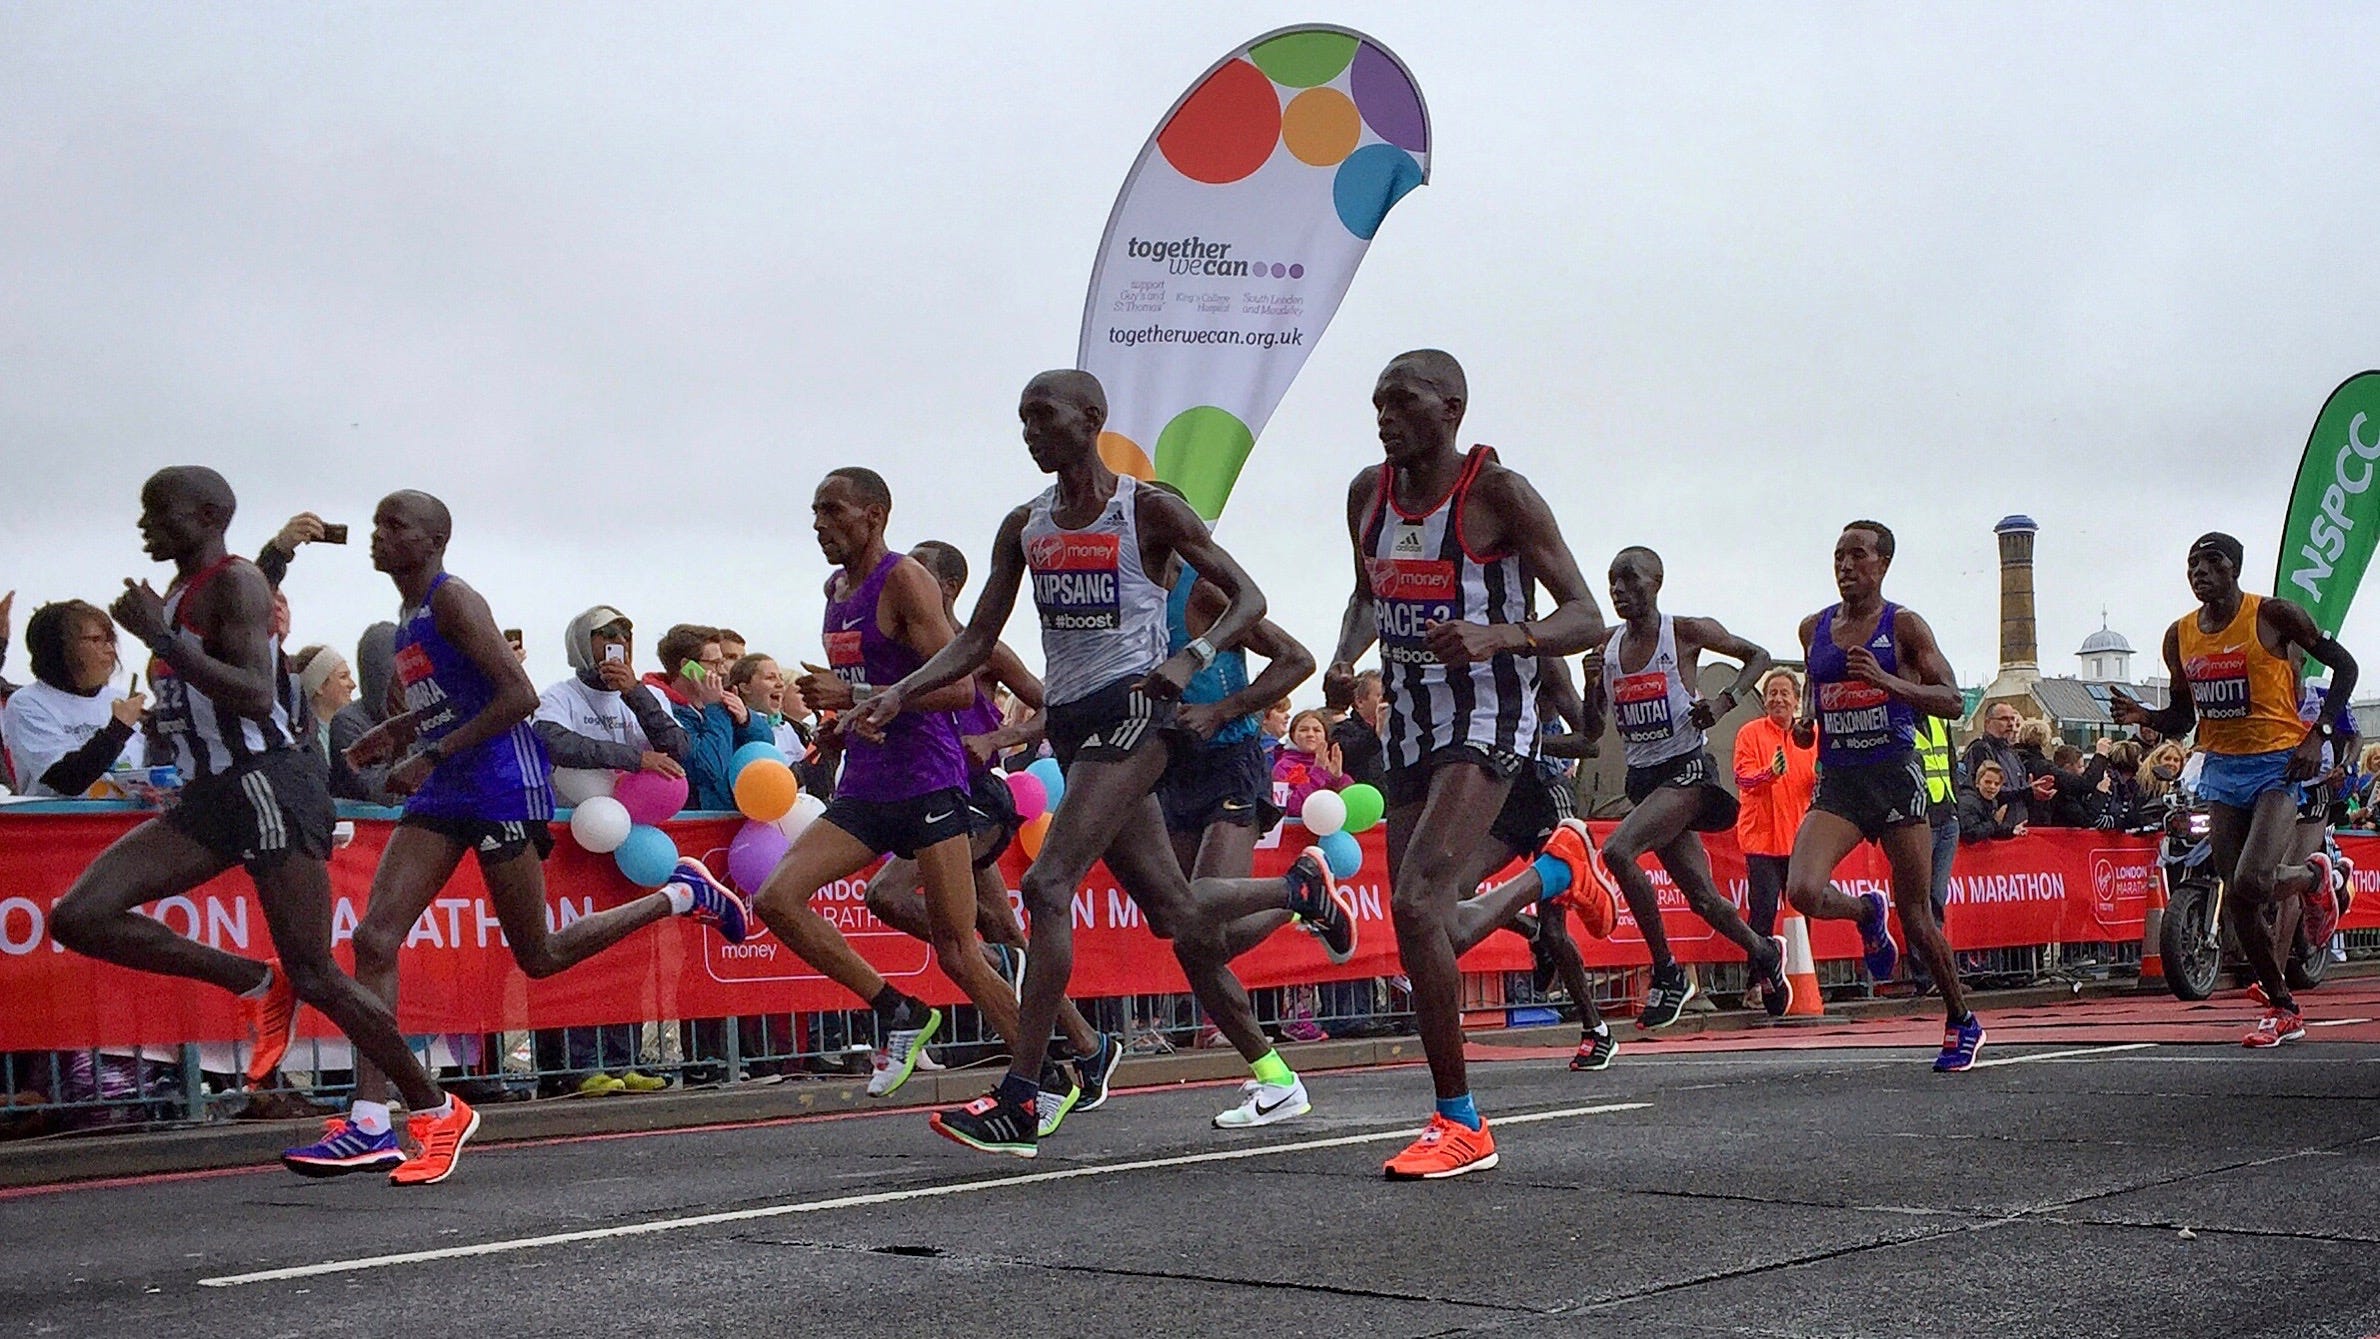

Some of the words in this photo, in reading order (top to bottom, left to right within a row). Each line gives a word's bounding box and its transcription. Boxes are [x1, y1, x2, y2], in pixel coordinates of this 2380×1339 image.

[1128, 236, 1231, 262] together
[1109, 325, 1303, 349] togetherwecan.org.uk
[2290, 411, 2380, 603] NSPCC
[1067, 544, 1114, 560] money
[1034, 573, 1116, 605] KIPSANG
[1401, 573, 1450, 589] money
[1055, 612, 1114, 629] #boost
[1374, 599, 1426, 637] PACE
[1392, 646, 1440, 663] #boo
[2211, 660, 2245, 671] money
[1623, 699, 1668, 726] MUTAI
[1823, 705, 1890, 735] MEKONNEN
[1845, 734, 1891, 749] #boost
[2115, 866, 2148, 879] LONDON
[1968, 872, 2065, 903] MARATHON
[721, 943, 777, 962] money
